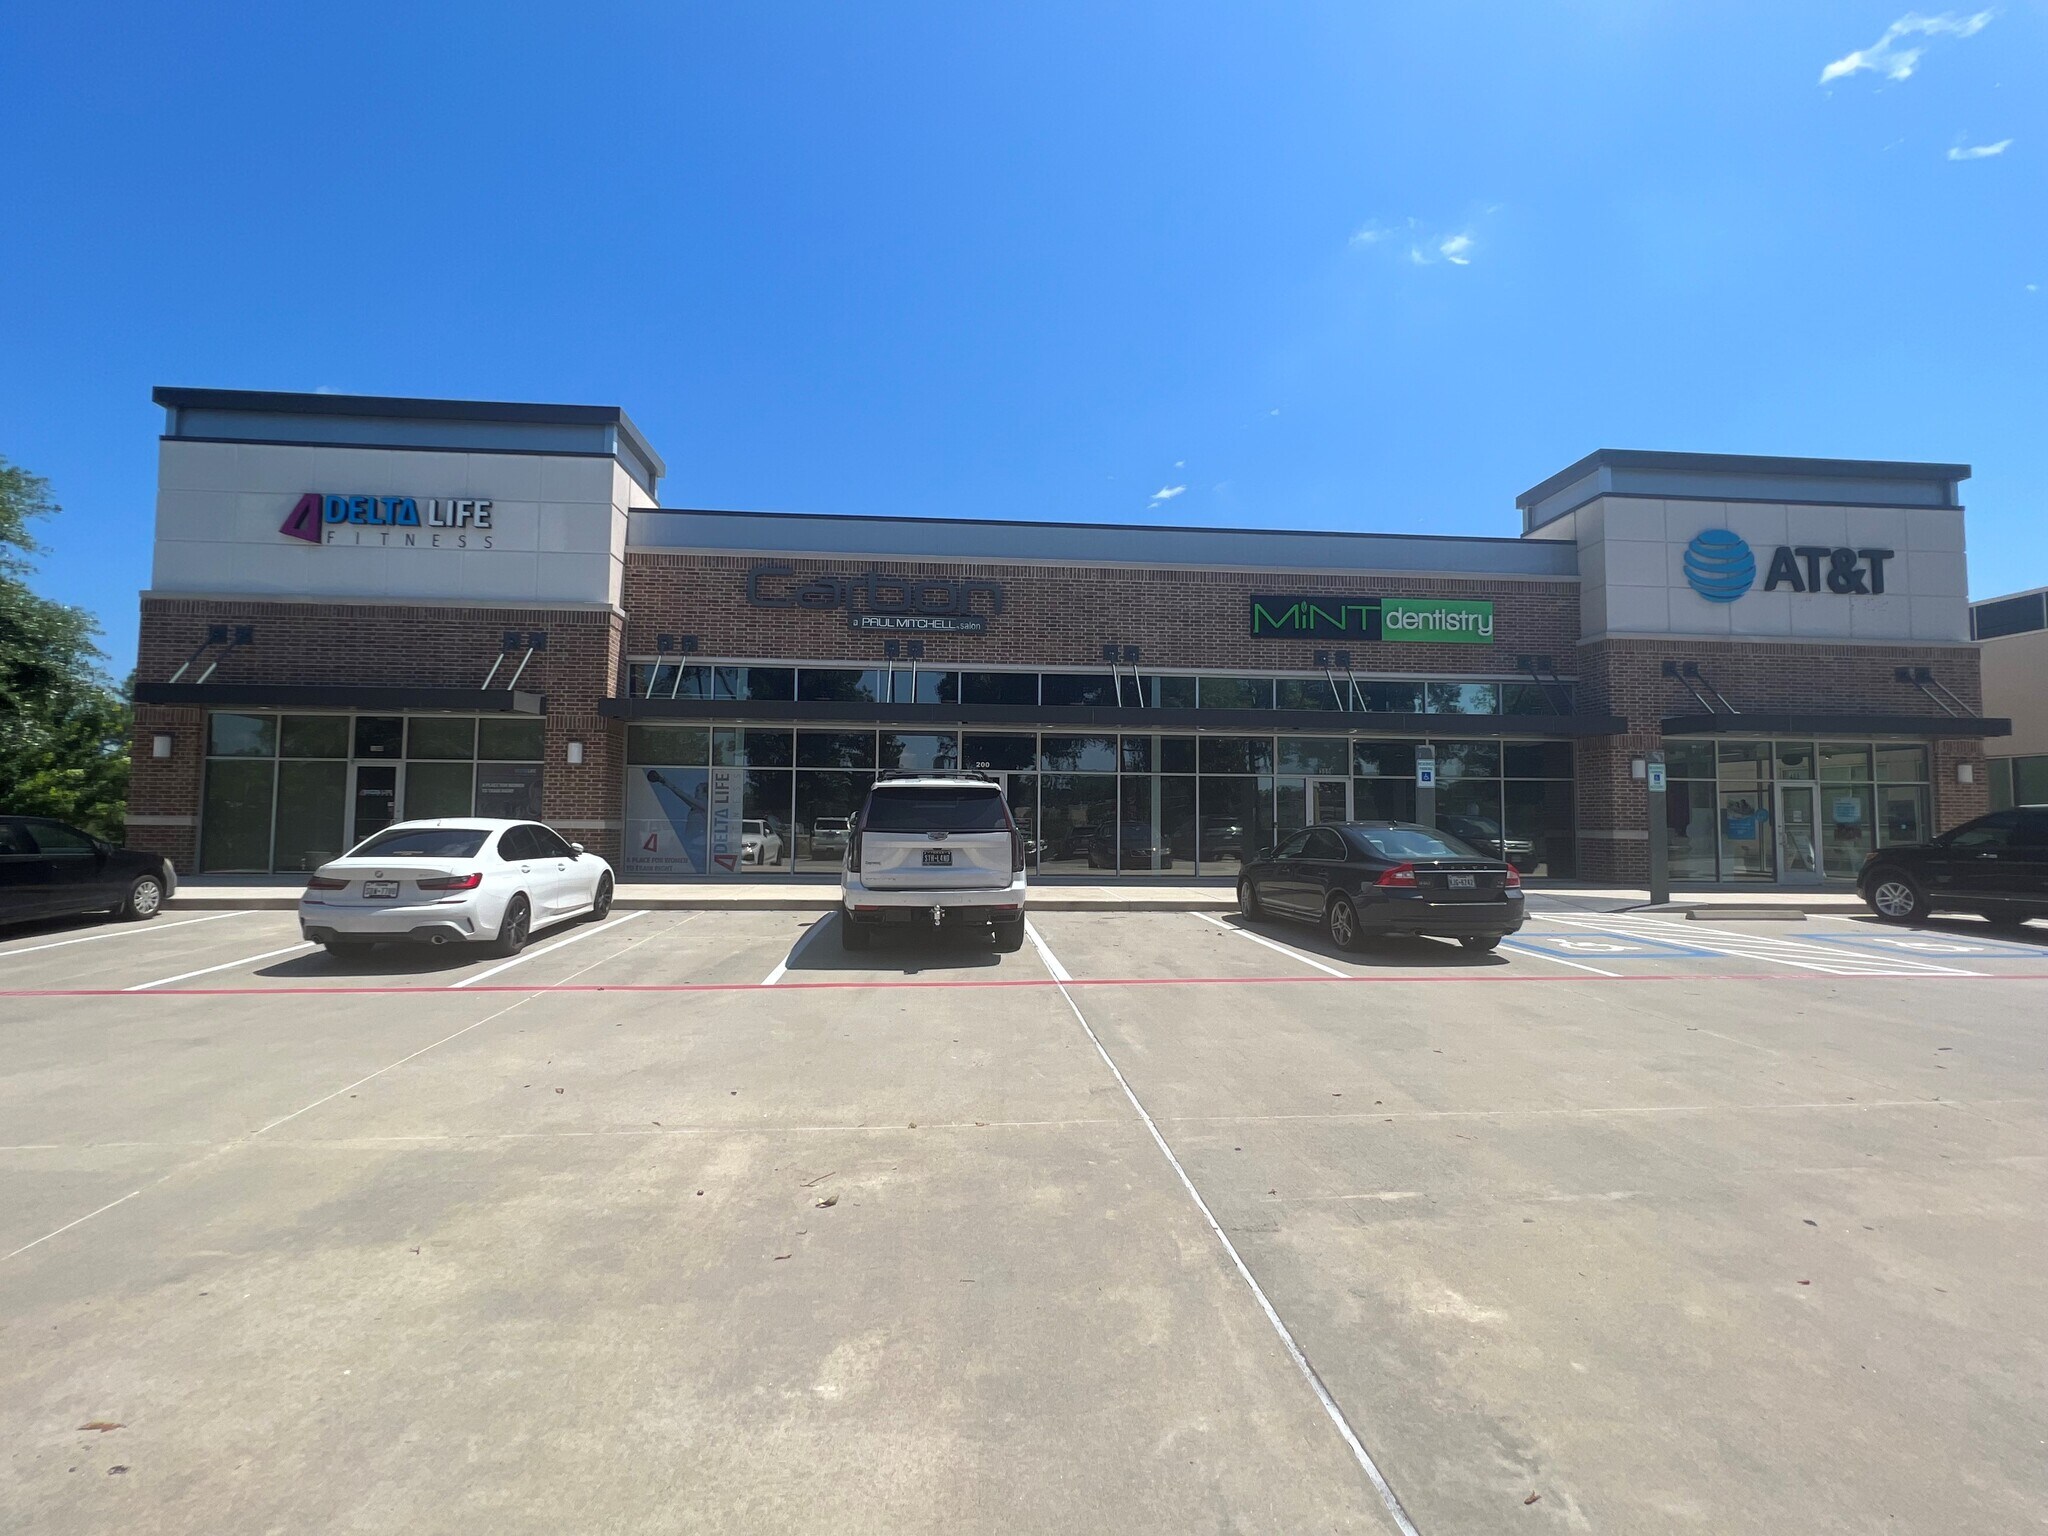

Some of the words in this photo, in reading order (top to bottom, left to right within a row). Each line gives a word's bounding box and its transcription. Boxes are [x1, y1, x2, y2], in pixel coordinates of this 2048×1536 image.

[325, 495, 421, 527] DELTA
[428, 499, 492, 529] LIFE
[326, 531, 493, 549] FITNESS
[1764, 546, 1895, 595] AT&T
[748, 565, 1002, 616] Carbon
[852, 618, 858, 627] a
[861, 617, 894, 628] PAUL
[896, 618, 956, 629] MITCHELL
[959, 622, 981, 630] salon
[1386, 606, 1493, 637] dentistry
[714, 773, 729, 804] LIFE
[713, 808, 728, 854] DELTA
